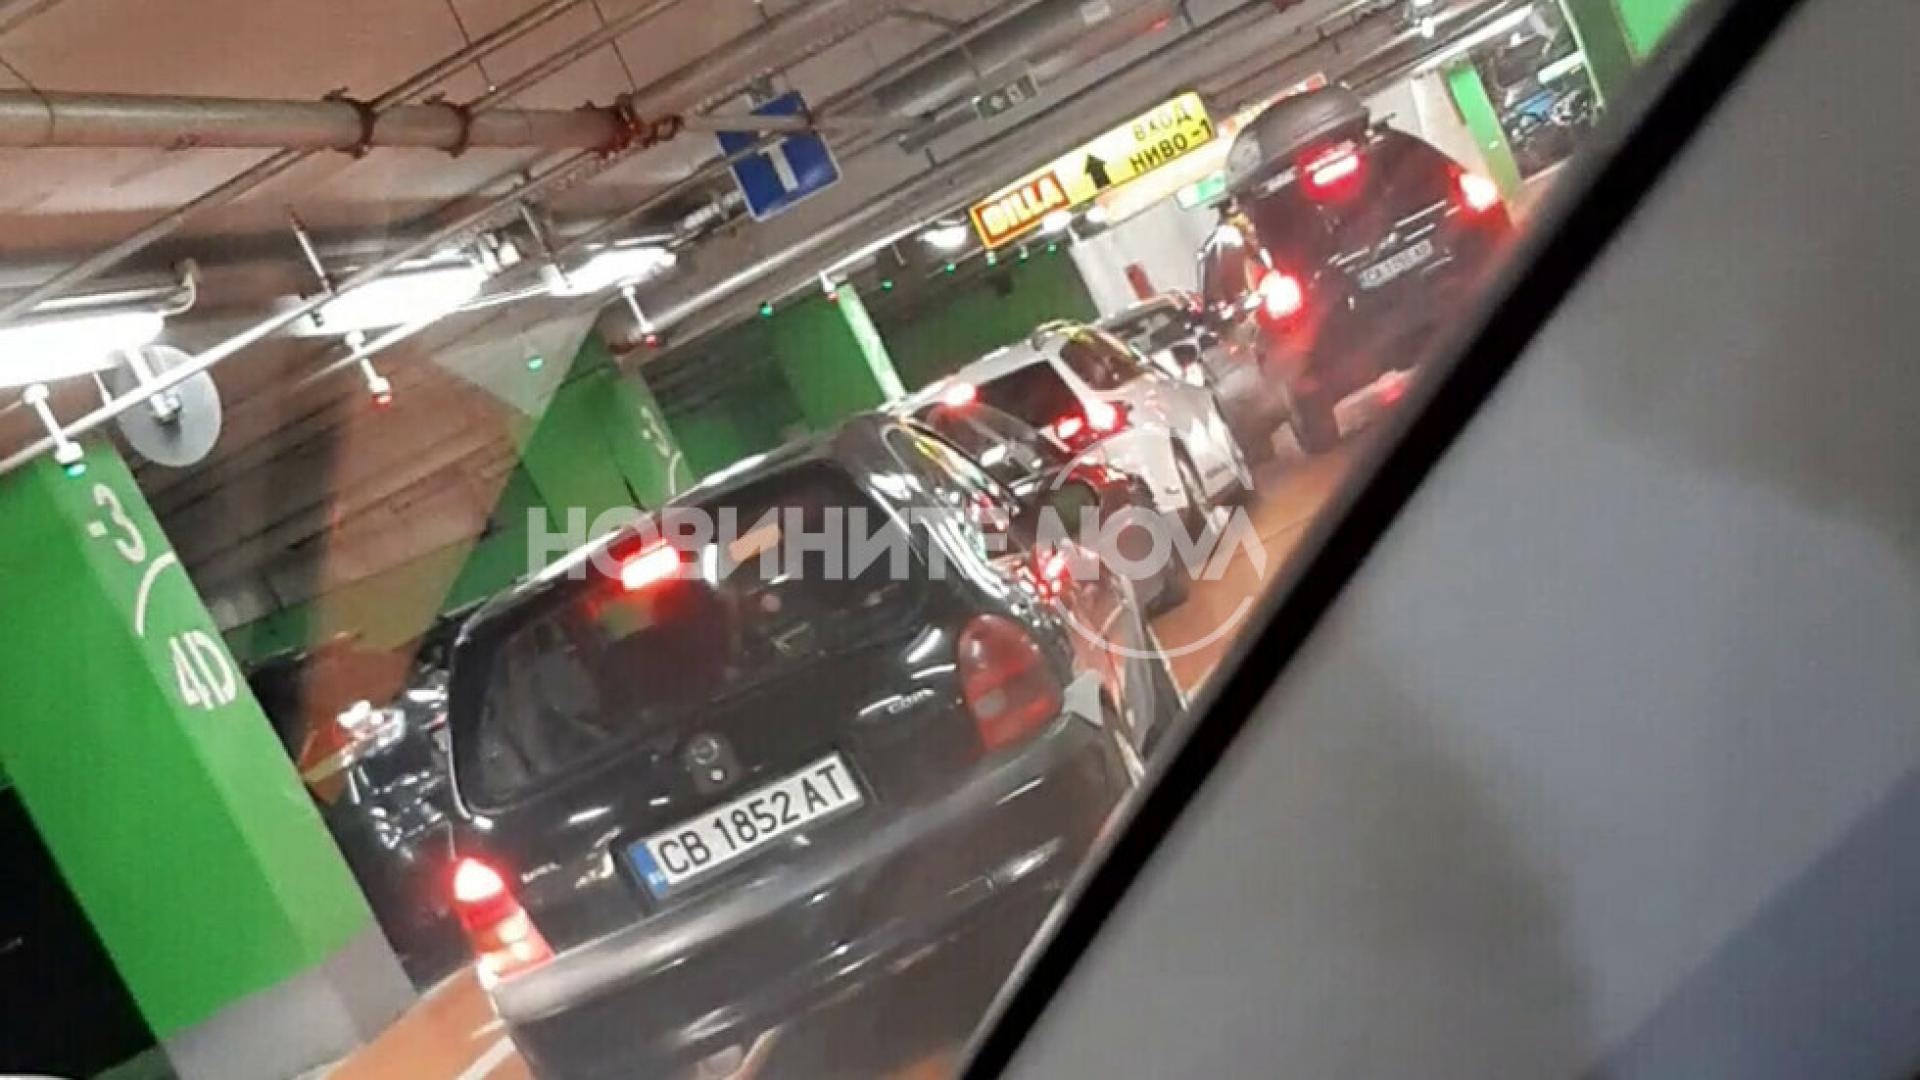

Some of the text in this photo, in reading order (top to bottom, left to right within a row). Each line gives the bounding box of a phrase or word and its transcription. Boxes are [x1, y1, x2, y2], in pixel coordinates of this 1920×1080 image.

[1129, 132, 1188, 174] НИВО
[981, 176, 1065, 236] BILLA
[168, 630, 236, 711] 4D
[657, 763, 850, 876] CB 1852 AT
